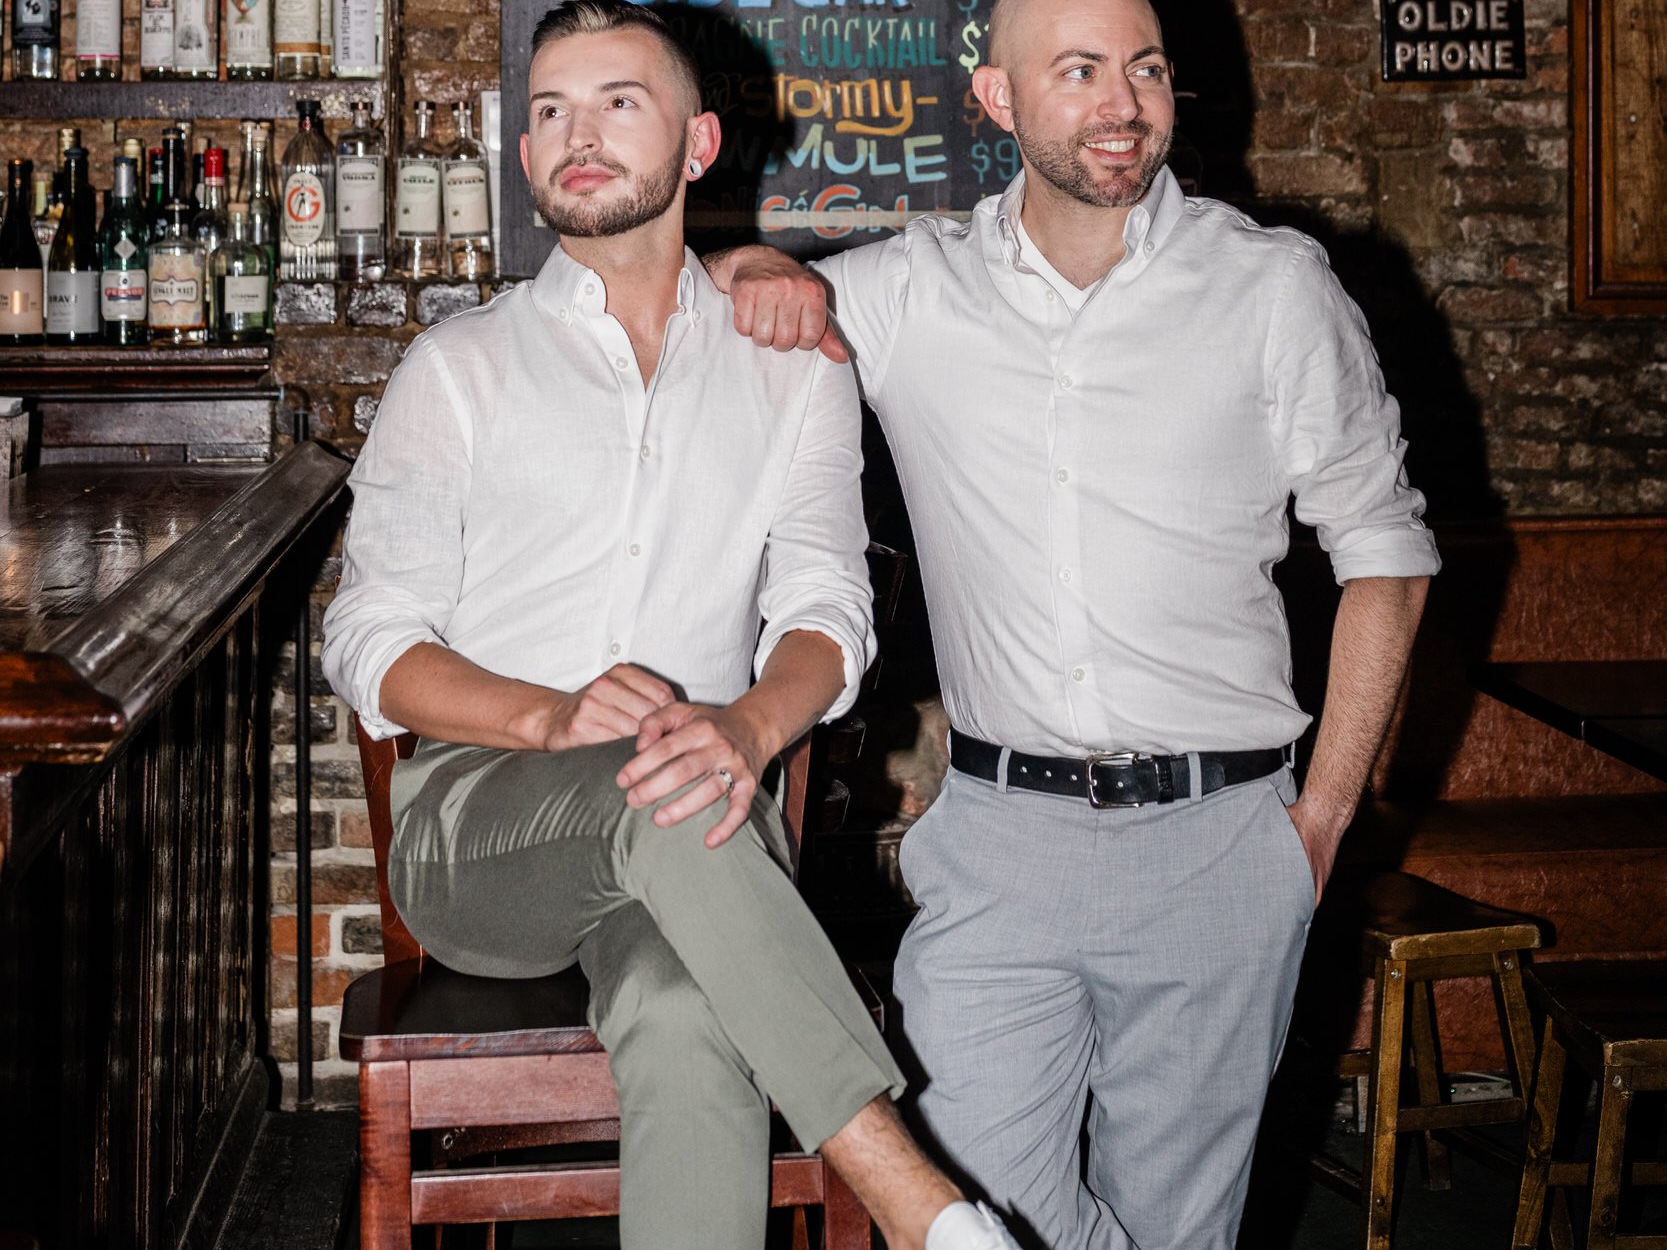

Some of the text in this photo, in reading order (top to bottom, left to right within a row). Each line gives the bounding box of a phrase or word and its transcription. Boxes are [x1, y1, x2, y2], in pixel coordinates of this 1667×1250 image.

[1398, 0, 1510, 33] OLDIE
[800, 13, 947, 70] COCKTAIL
[1394, 40, 1516, 73] PHONE
[762, 122, 949, 184] MULE
[969, 138, 1020, 186] $9
